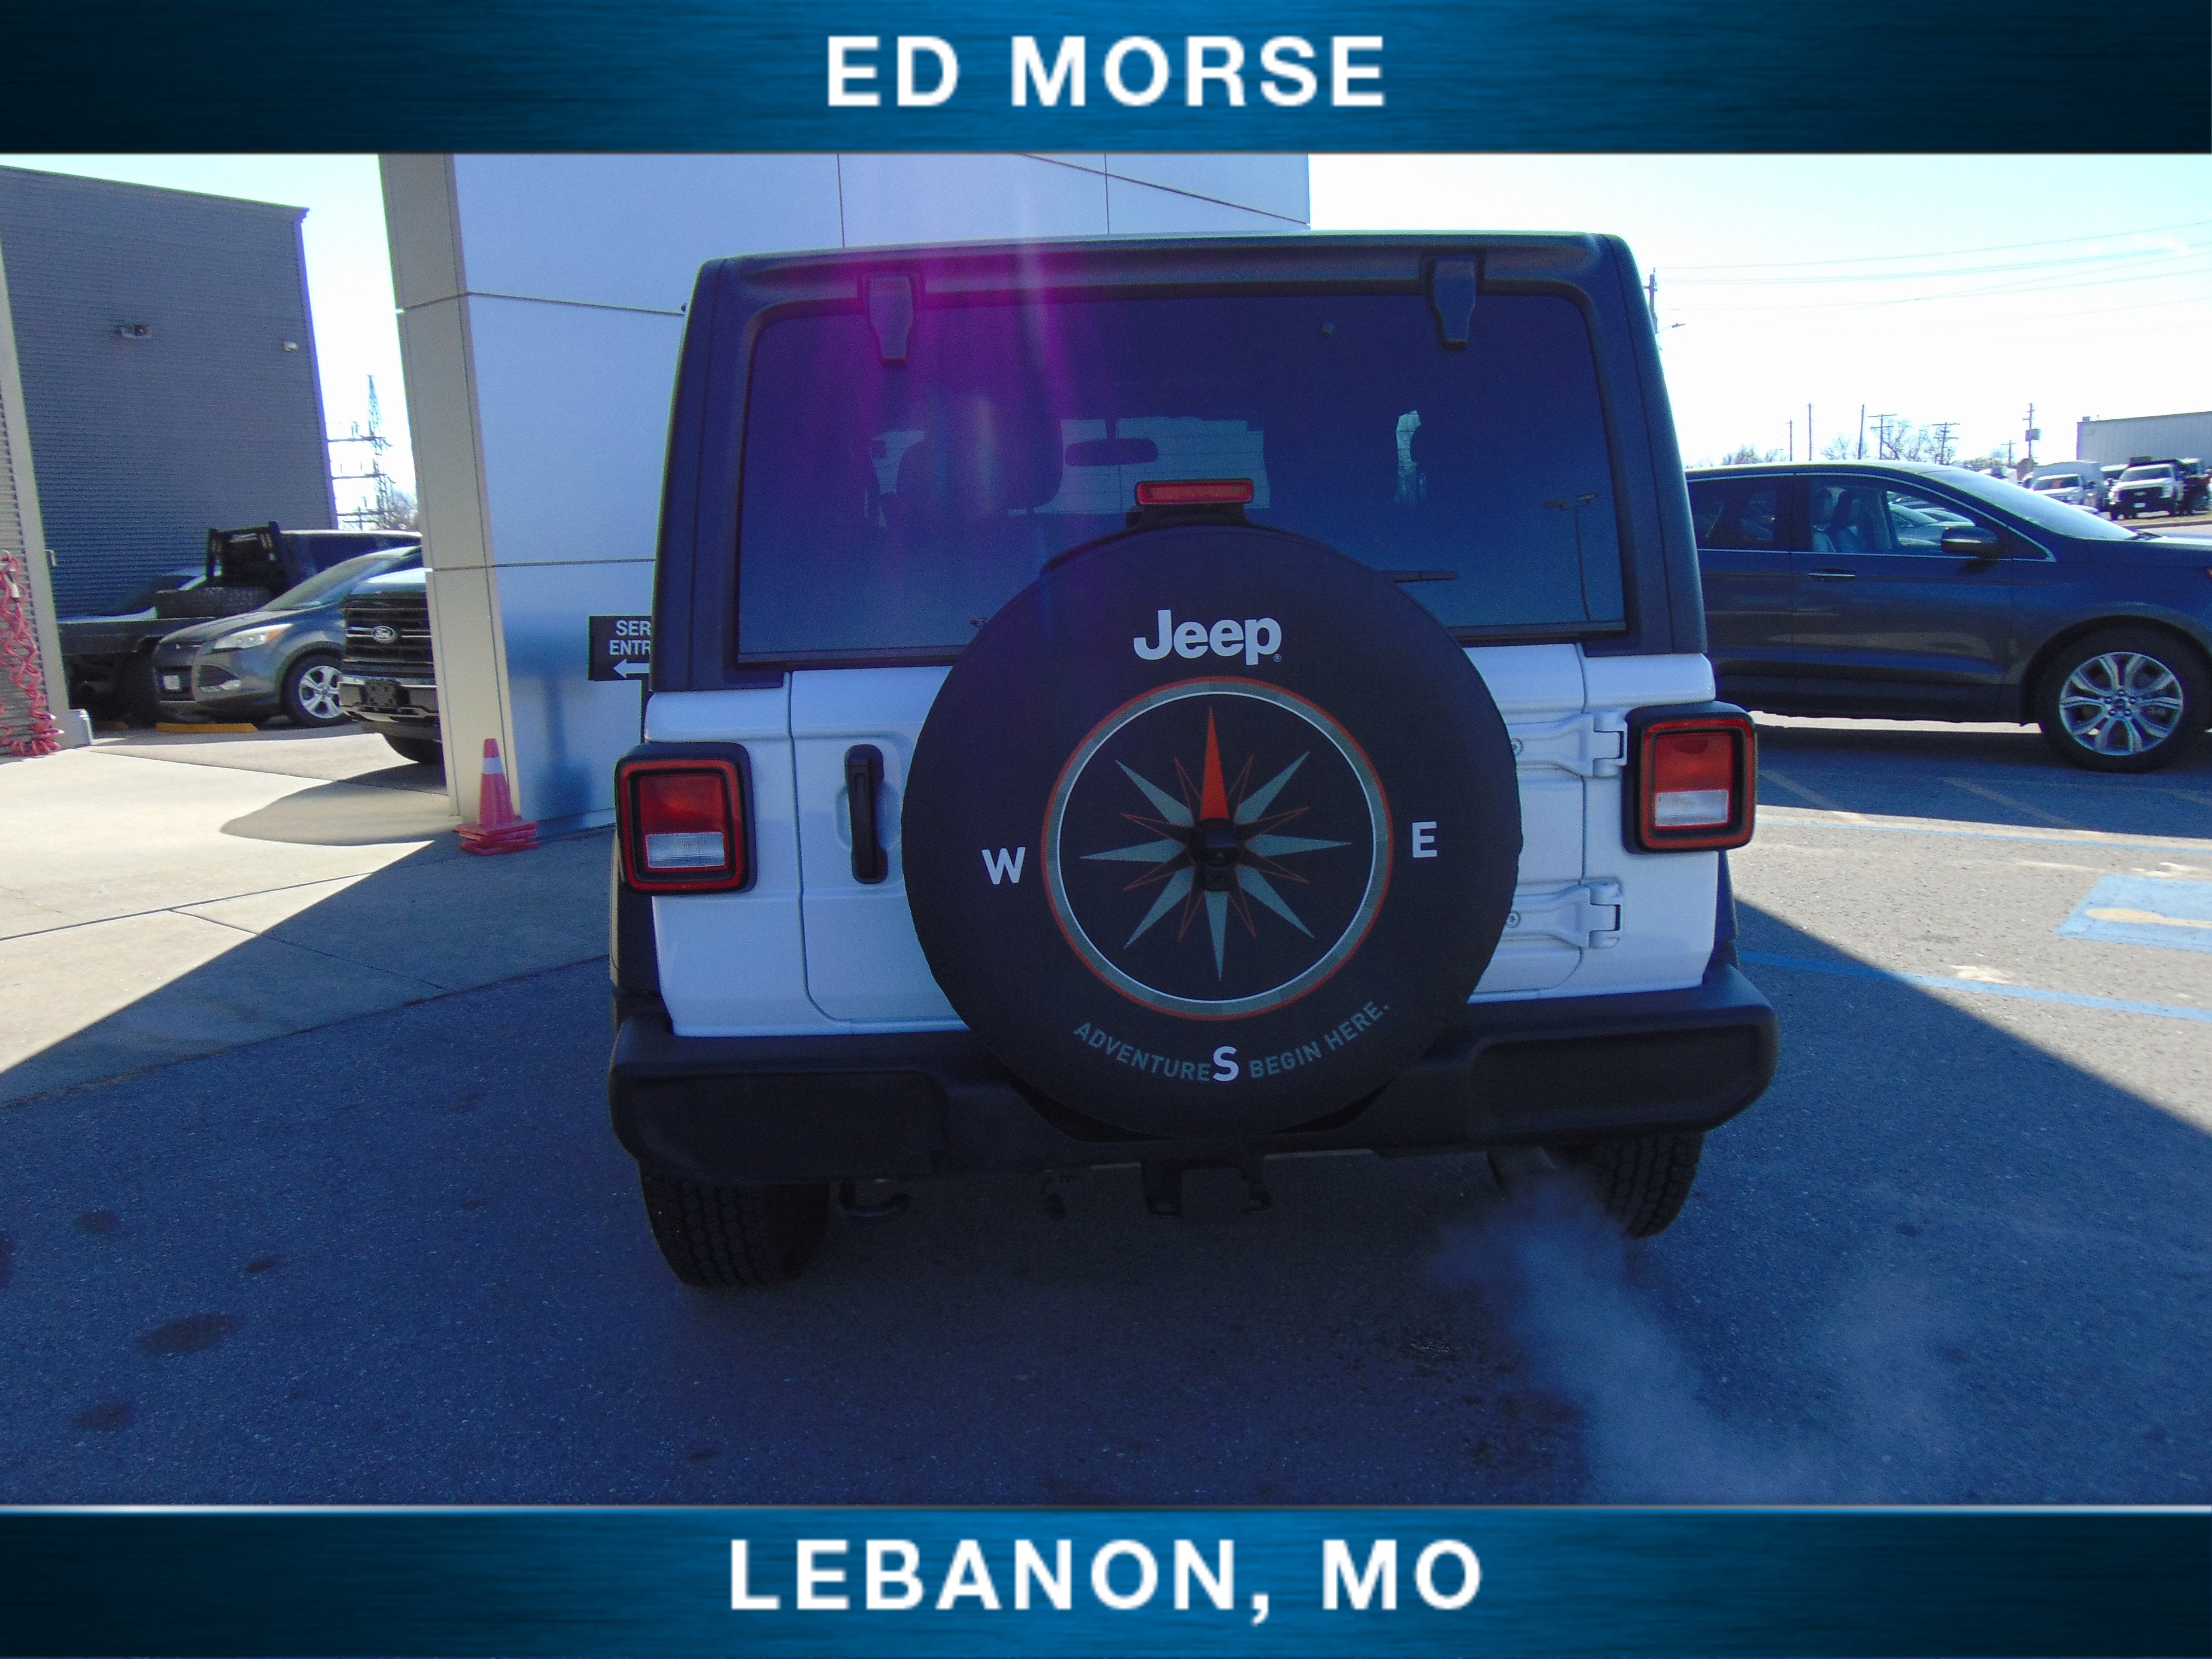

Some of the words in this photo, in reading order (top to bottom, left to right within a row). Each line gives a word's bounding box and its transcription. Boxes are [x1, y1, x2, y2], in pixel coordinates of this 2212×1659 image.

[1133, 609, 1282, 665] Jeep
[1412, 821, 1437, 858] E
[981, 847, 1026, 885] W
[1249, 1041, 1322, 1079] BEGIN
[1324, 1001, 1389, 1051] HERE.
